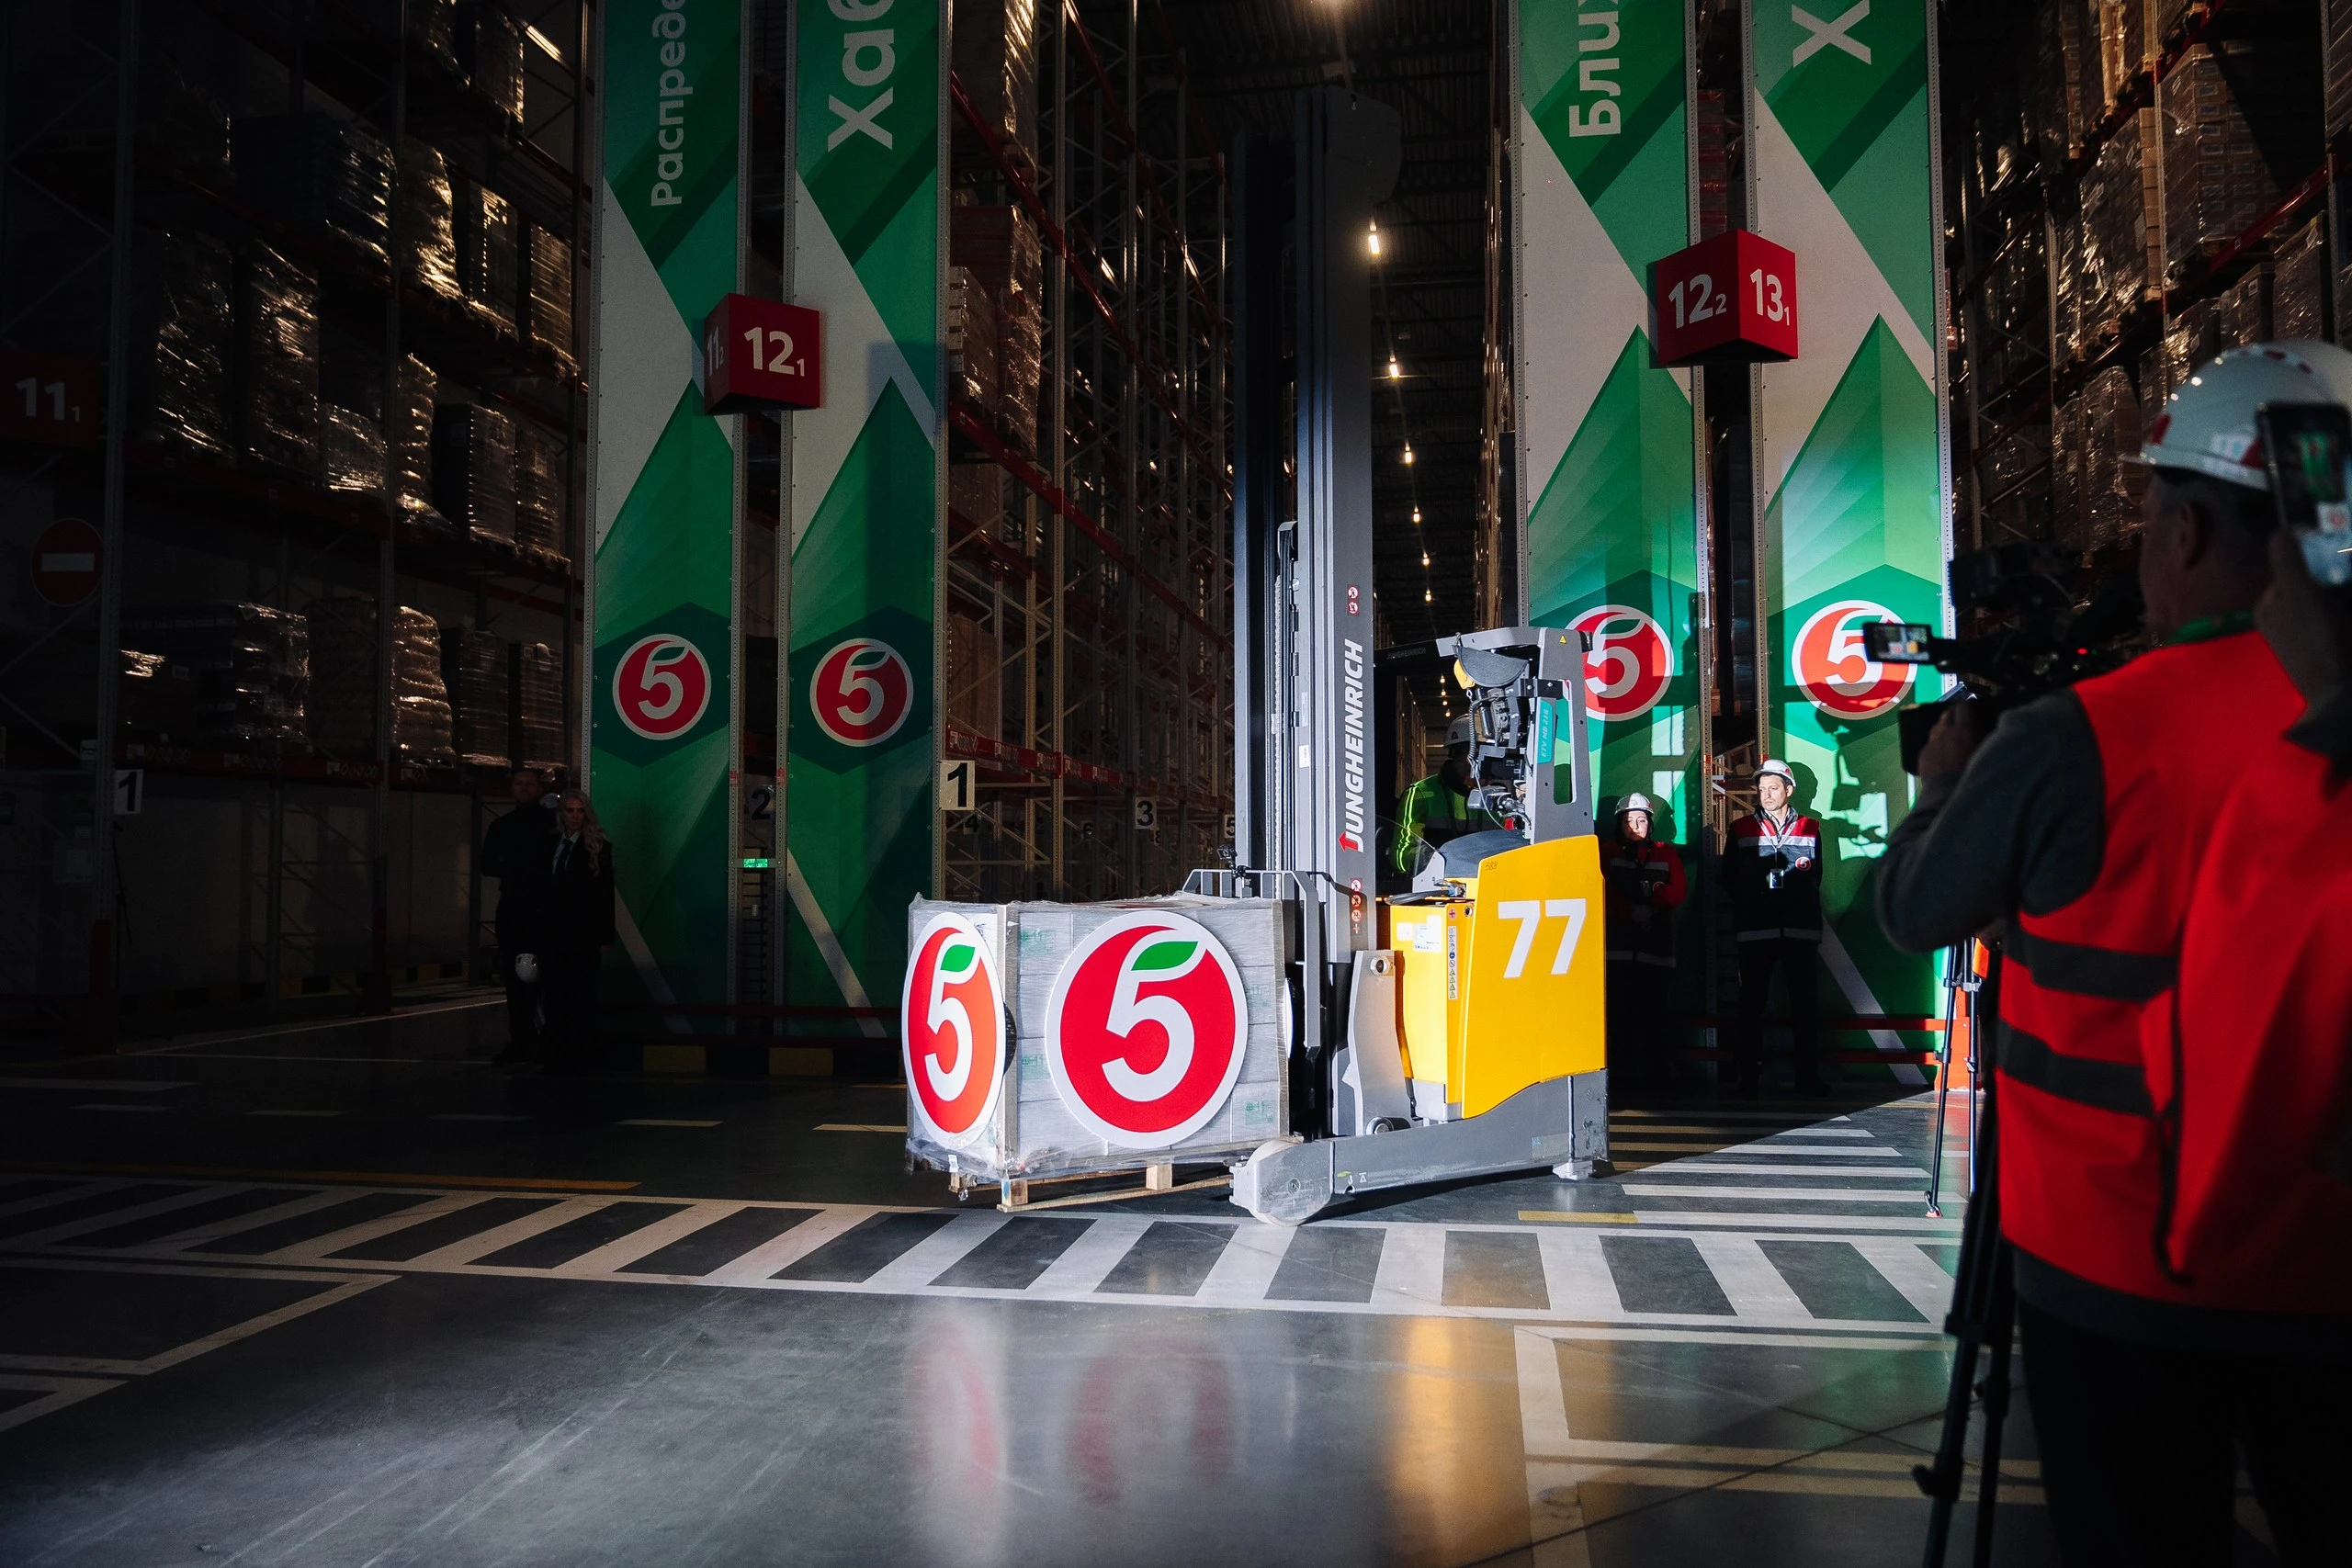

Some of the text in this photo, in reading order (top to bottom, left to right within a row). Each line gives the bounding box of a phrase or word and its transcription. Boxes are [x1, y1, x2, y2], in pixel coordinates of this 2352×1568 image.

[1568, 0, 1622, 138] Бли
[946, 762, 968, 807] 1
[1343, 638, 1364, 853] JUNGHEINRICH
[119, 771, 137, 812] 1
[752, 789, 771, 819] 2
[1136, 800, 1154, 827] 3
[1497, 897, 1587, 979] 77
[924, 931, 981, 1102] 5
[1102, 929, 1209, 1102] 5
